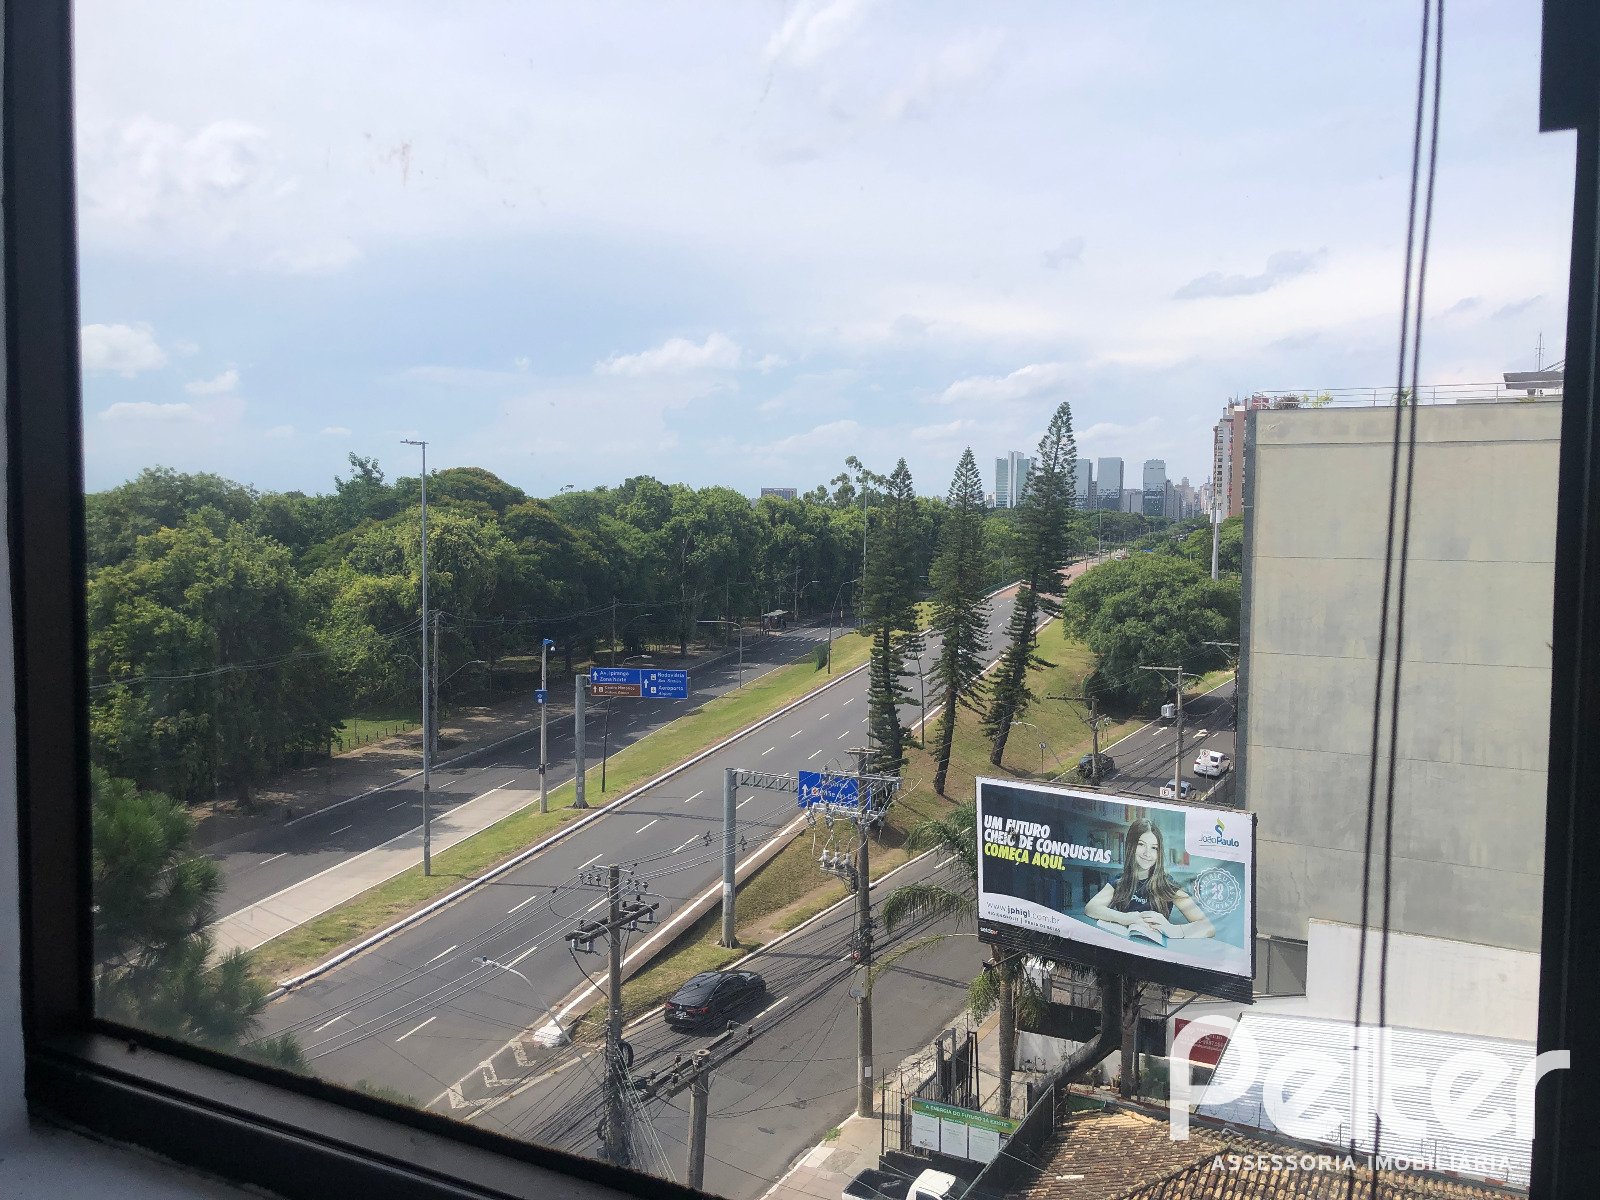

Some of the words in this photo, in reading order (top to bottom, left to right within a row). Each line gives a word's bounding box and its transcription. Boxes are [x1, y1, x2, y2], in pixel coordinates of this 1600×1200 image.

[984, 815, 1003, 830] UM
[1005, 819, 1050, 839] FUTURO
[984, 842, 1030, 866] COMEÇA
[1031, 852, 1066, 871] AQUI.
[1018, 835, 1034, 850] DE
[1036, 838, 1112, 864] CONQUISTAS
